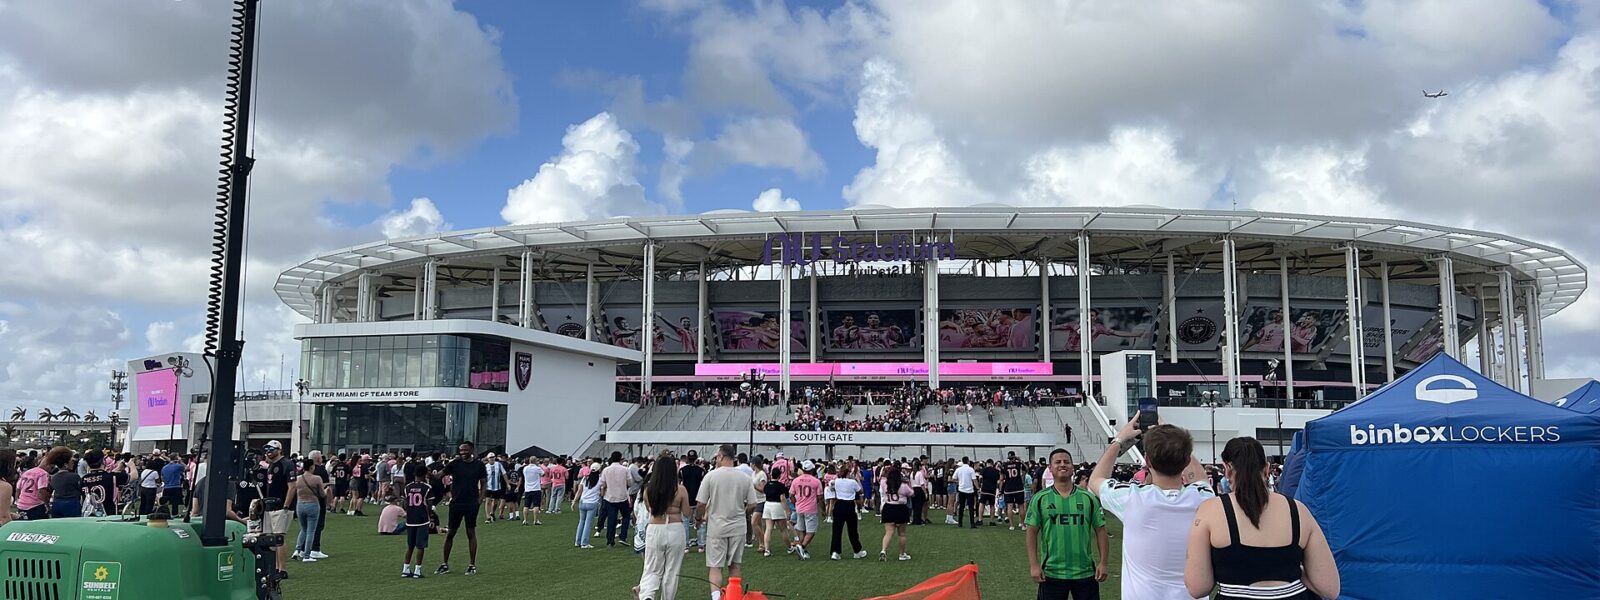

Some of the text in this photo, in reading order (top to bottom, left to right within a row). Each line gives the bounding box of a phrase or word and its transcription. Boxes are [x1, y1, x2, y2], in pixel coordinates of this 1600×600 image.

[831, 234, 956, 262] Stadium
[794, 433, 854, 441] SOUTH GATE
[1450, 426, 1561, 442] LOCKERS
[1007, 468, 1018, 478] 10
[798, 485, 812, 497] 10
[407, 492, 423, 506] 10
[1048, 513, 1084, 525] YETI
[83, 581, 117, 589] SUNBELT
